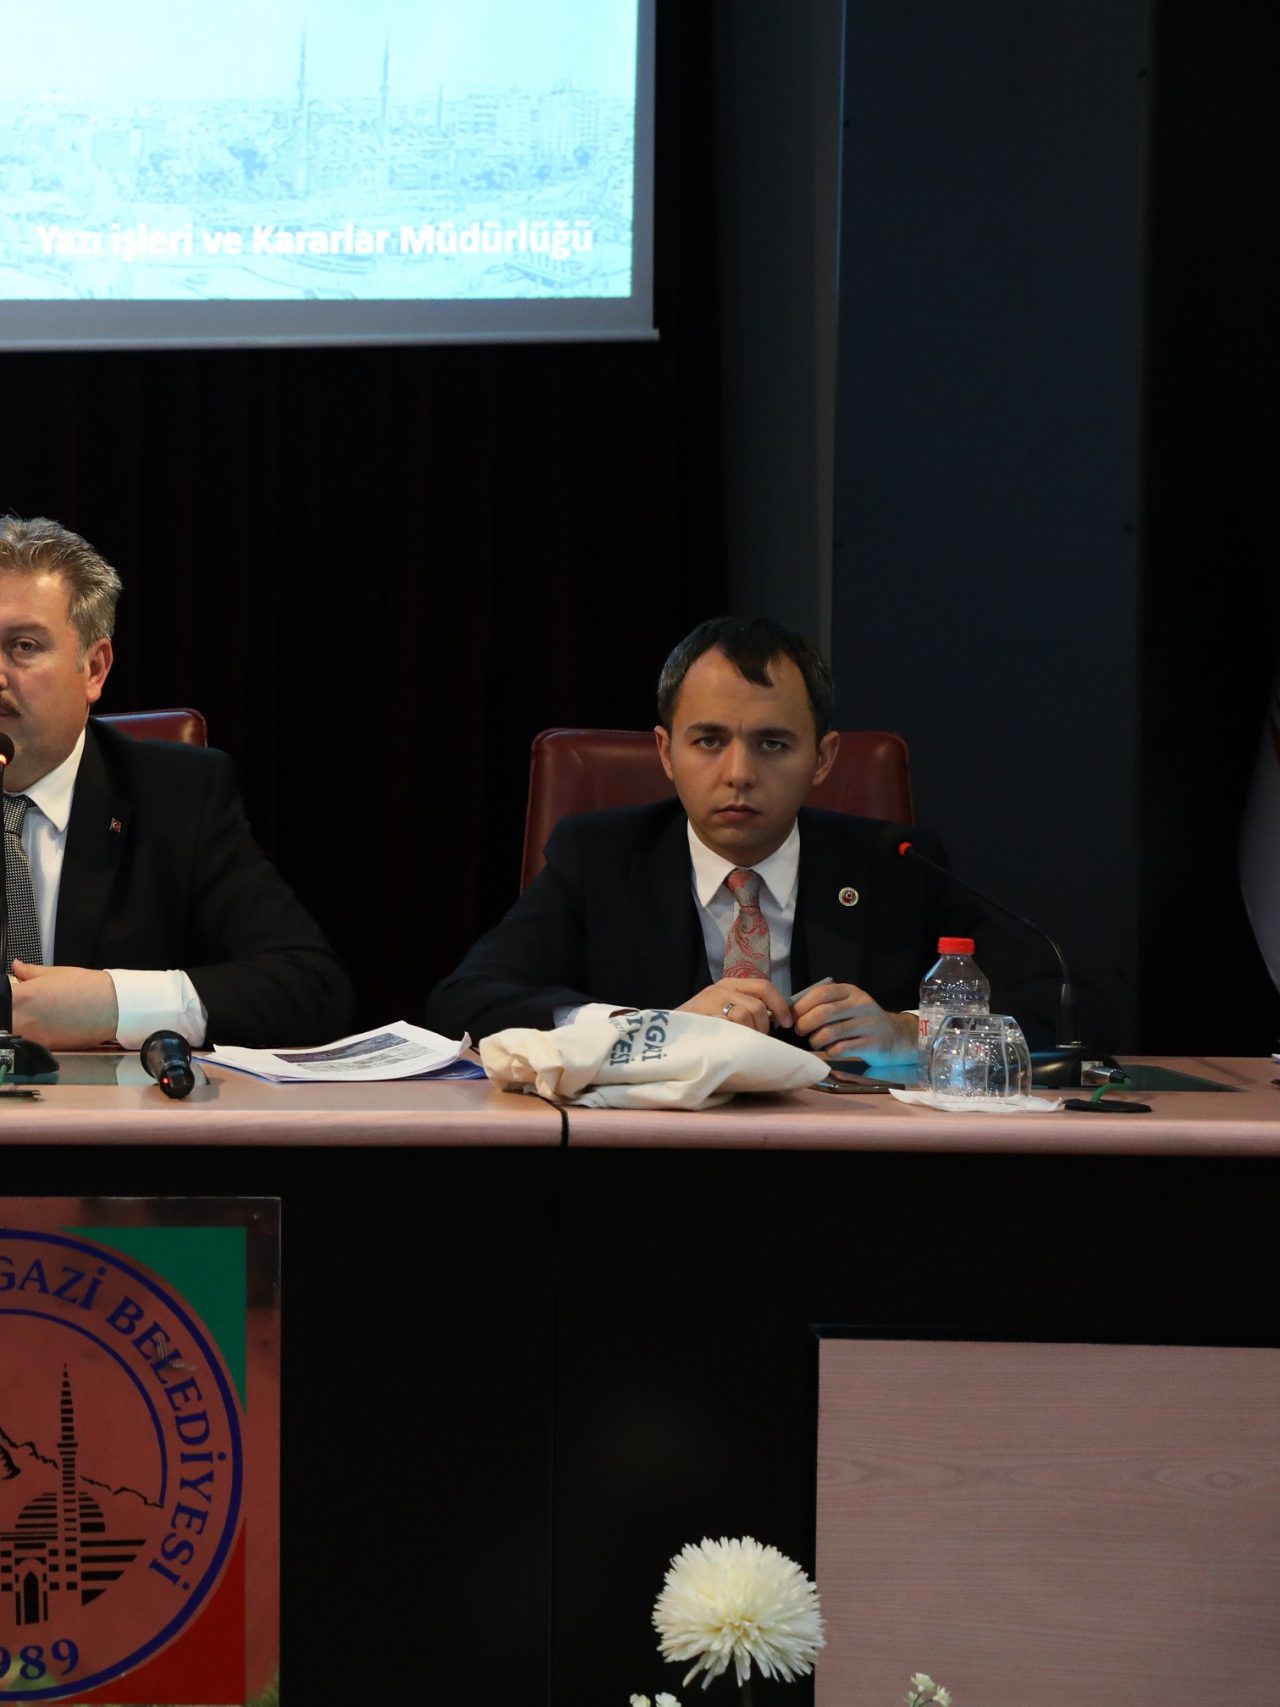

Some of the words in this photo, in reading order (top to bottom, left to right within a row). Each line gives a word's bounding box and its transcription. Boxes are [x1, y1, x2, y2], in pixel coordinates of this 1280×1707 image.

[202, 230, 243, 254] ve
[253, 221, 391, 255] Kararlar
[400, 219, 594, 260] Müdürlüğü
[104, 1296, 227, 1593] BELEDİYESİ
